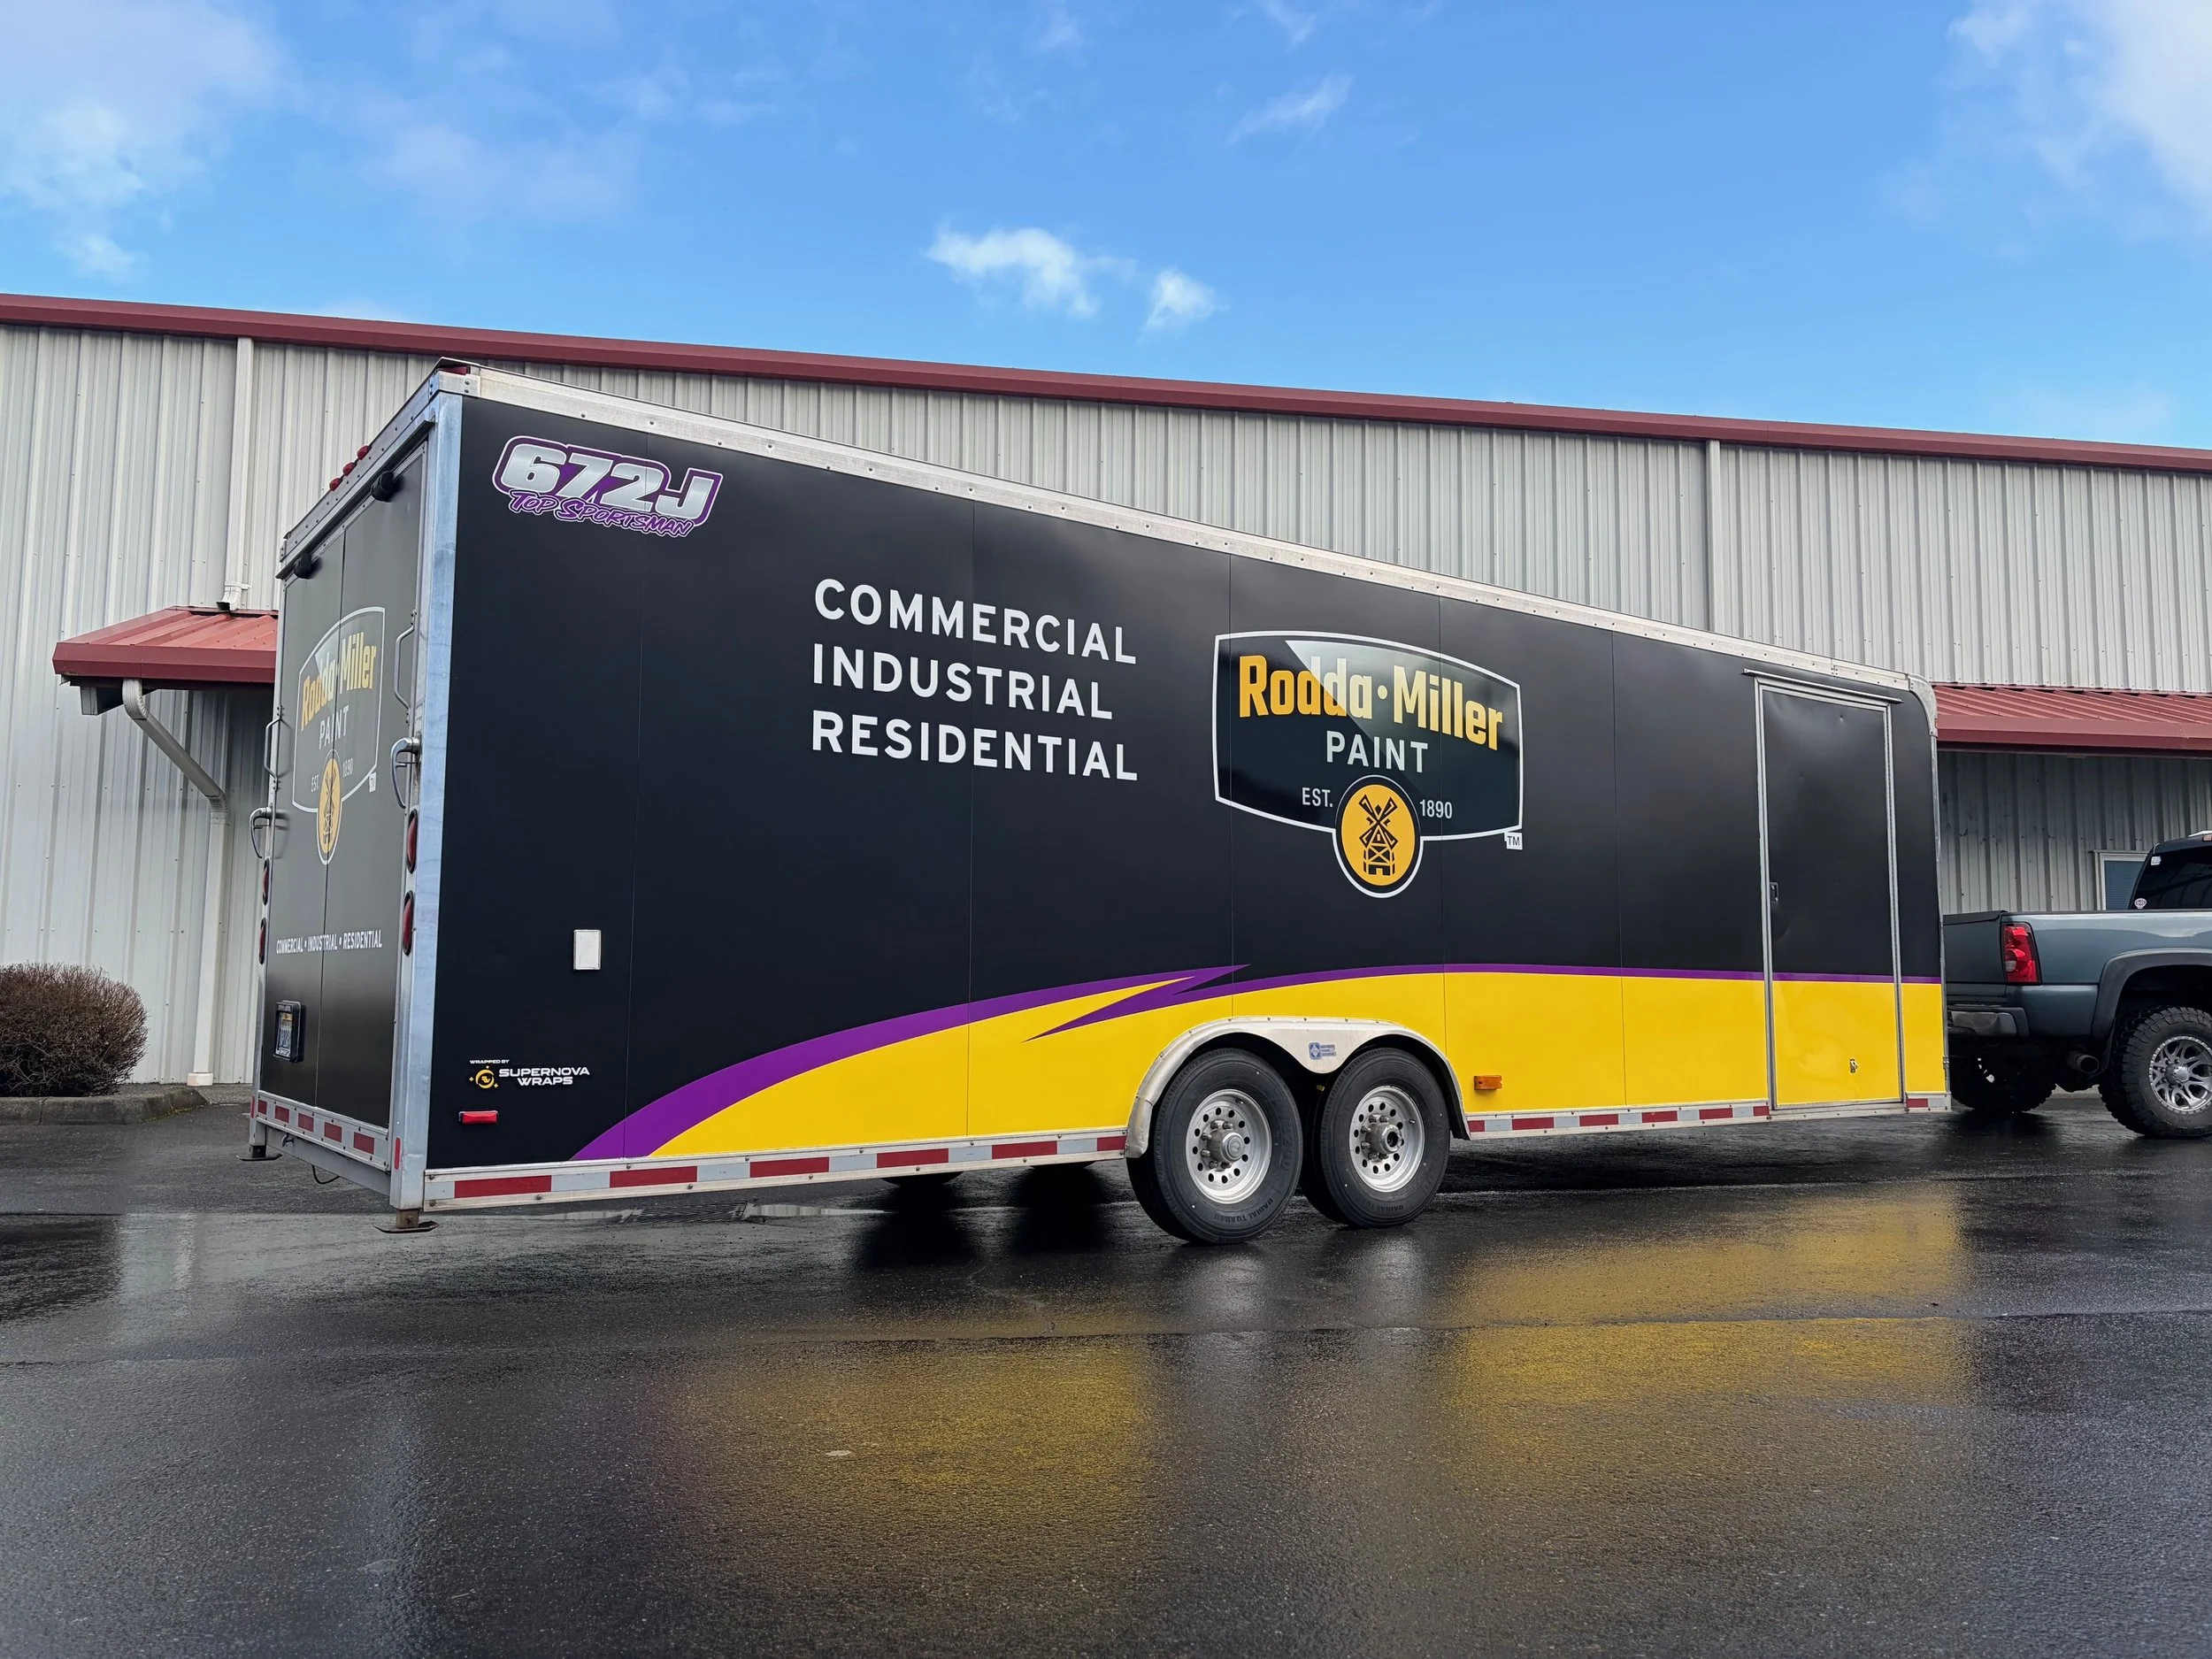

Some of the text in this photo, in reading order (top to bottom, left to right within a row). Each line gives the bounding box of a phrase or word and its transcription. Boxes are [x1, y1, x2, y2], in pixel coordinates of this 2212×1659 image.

[499, 442, 716, 521] 672J
[509, 490, 695, 536] TOP SPORTSMAN
[815, 578, 1136, 665] COMMERCIAL
[340, 631, 377, 695] Miller
[813, 642, 1112, 720] INDUSTRIAL
[1239, 655, 1503, 751] Rodda Miller
[319, 704, 349, 750] PAINT
[812, 709, 1138, 781] RESIDENTIAL
[1326, 730, 1429, 773] PAINT
[1302, 787, 1453, 819] EST. 1890
[1507, 835, 1520, 846] TM
[276, 930, 382, 955] COMMERCIAL INDUSTRIAL RESIDENTIAL
[498, 1067, 590, 1077] SUPERNOVA
[517, 1077, 572, 1086] WRAPS
